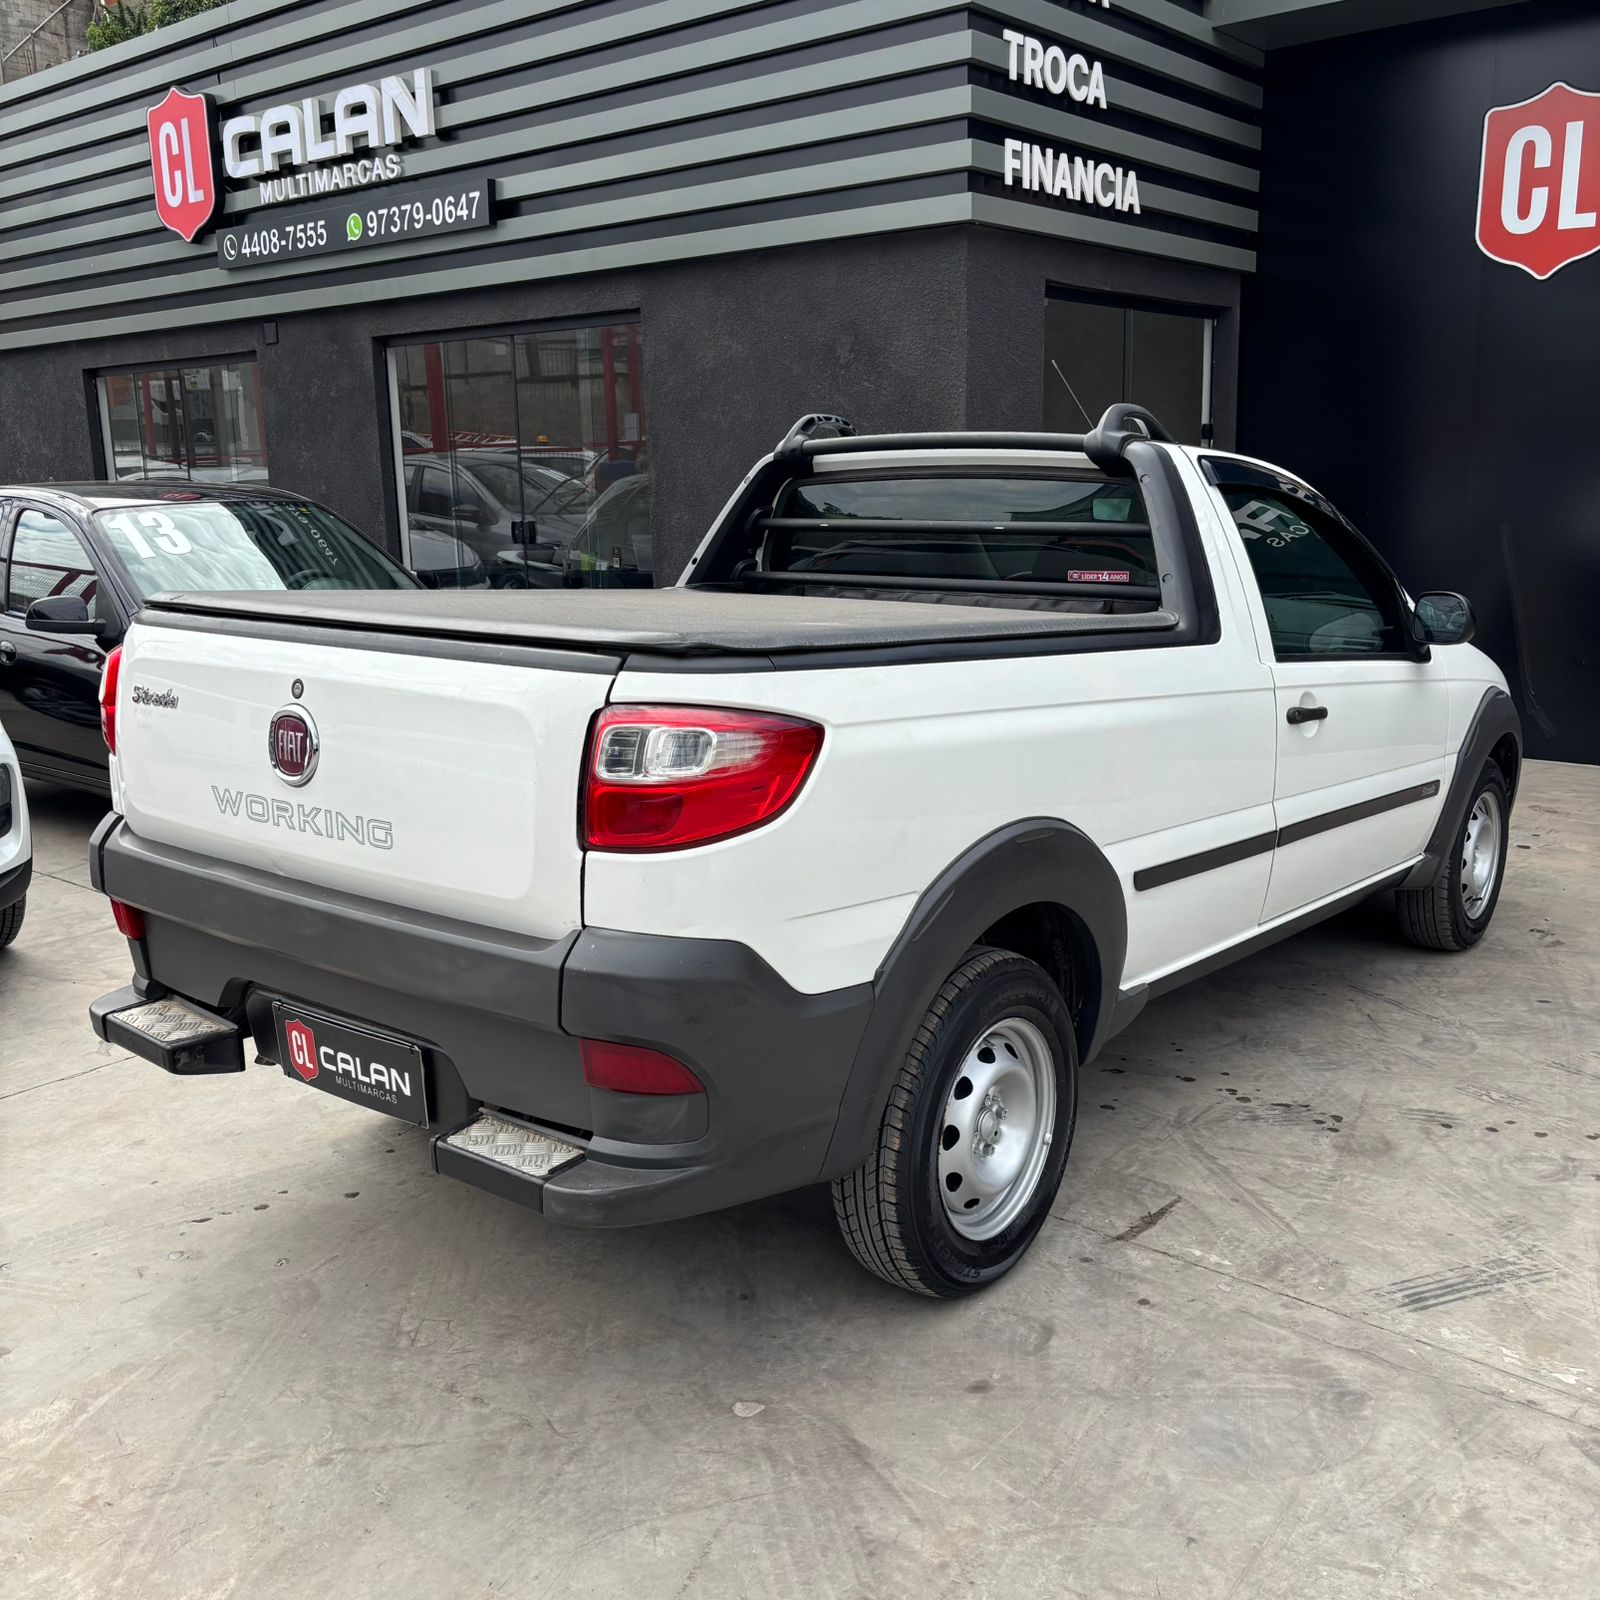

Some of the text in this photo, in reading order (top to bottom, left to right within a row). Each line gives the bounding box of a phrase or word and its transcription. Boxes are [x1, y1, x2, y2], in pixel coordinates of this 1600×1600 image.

[1003, 29, 1108, 109] TROCA
[222, 67, 437, 178] CALAN
[157, 116, 204, 207] CL
[259, 153, 404, 204] MULTIMARCAS
[1004, 137, 1141, 215] FINANCIA
[1500, 120, 1597, 235] CL
[241, 190, 481, 259] 4408-7555 97379-0647
[108, 510, 193, 559] 13
[278, 728, 304, 764] FIAT
[211, 785, 394, 850] WORKING
[291, 1030, 314, 1069] CL
[319, 1045, 412, 1097] CALAN
[334, 1074, 398, 1105] MULTIMARCAS
